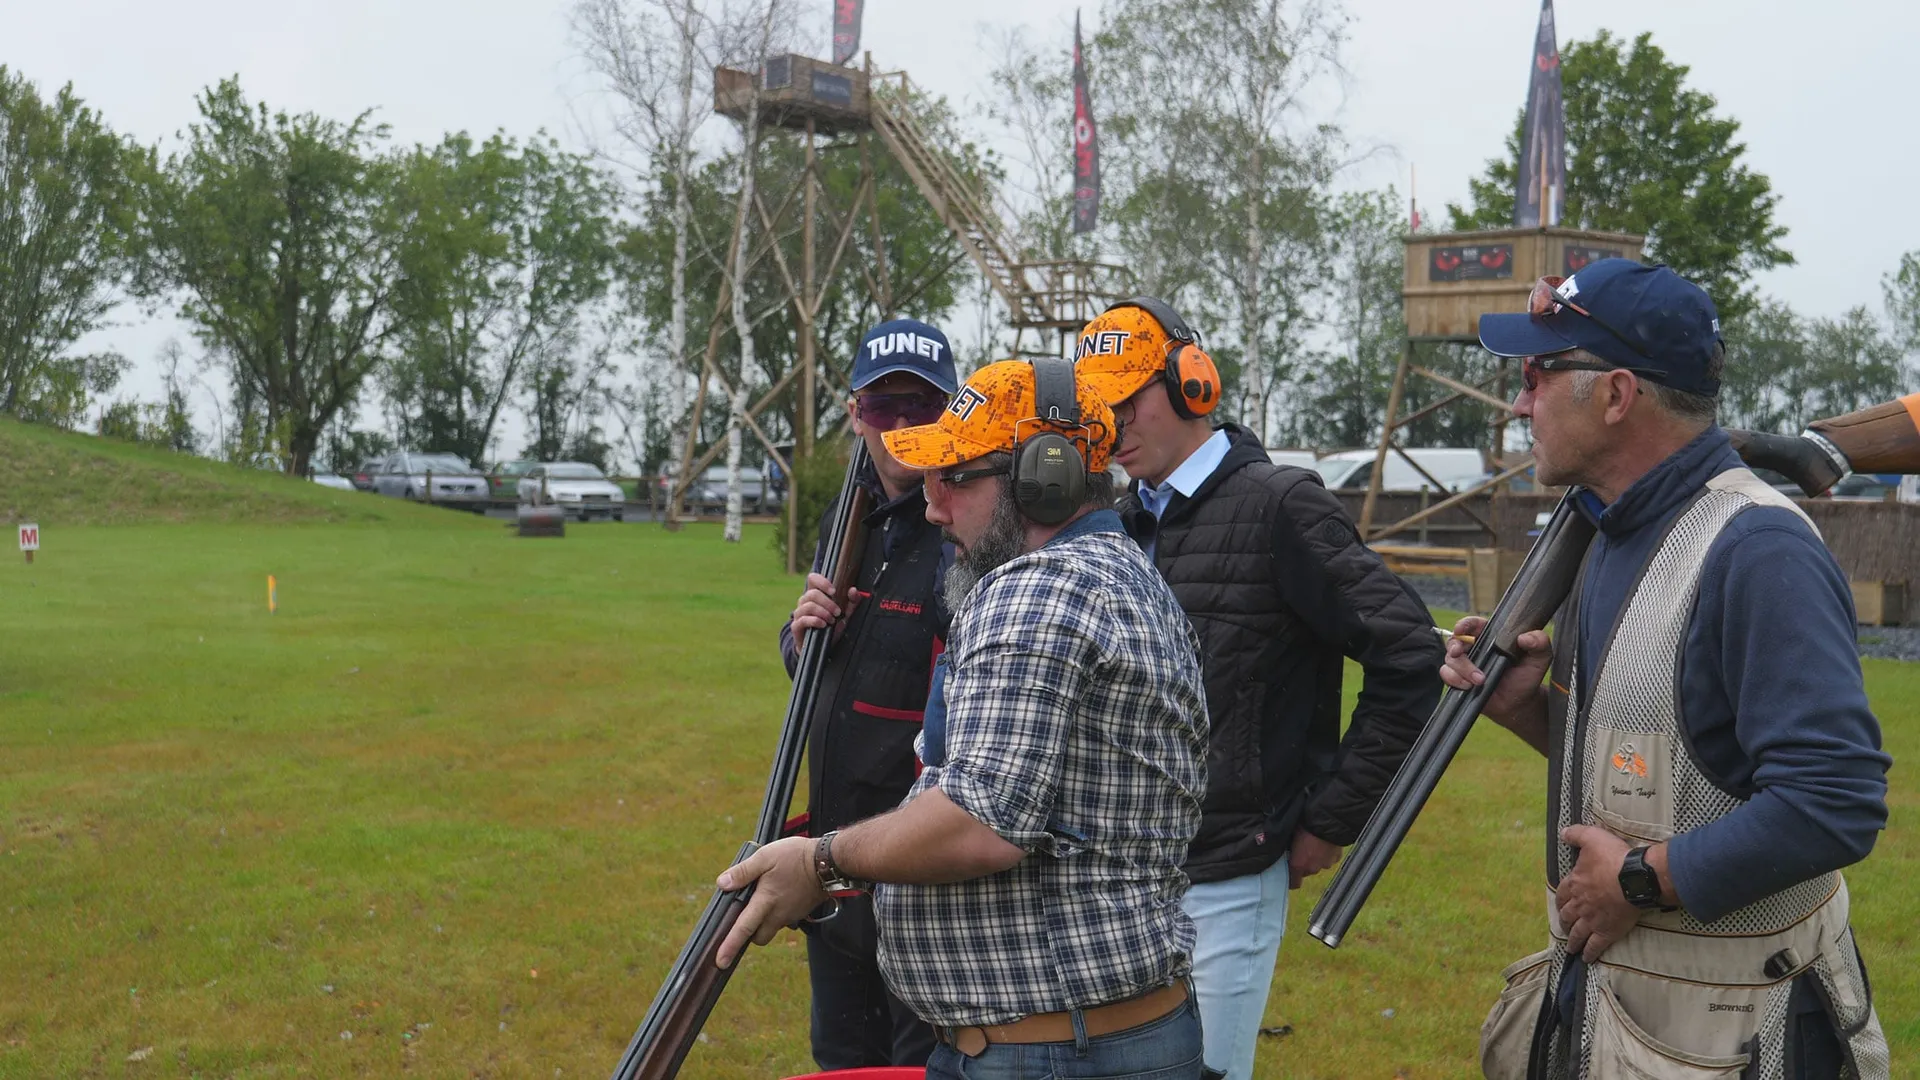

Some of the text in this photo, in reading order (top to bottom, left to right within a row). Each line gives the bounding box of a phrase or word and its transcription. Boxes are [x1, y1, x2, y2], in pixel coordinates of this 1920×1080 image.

[866, 332, 944, 362] TUNET
[1047, 447, 1061, 456] 3M
[21, 528, 38, 545] M
[1708, 1003, 1755, 1013] BROWNING
